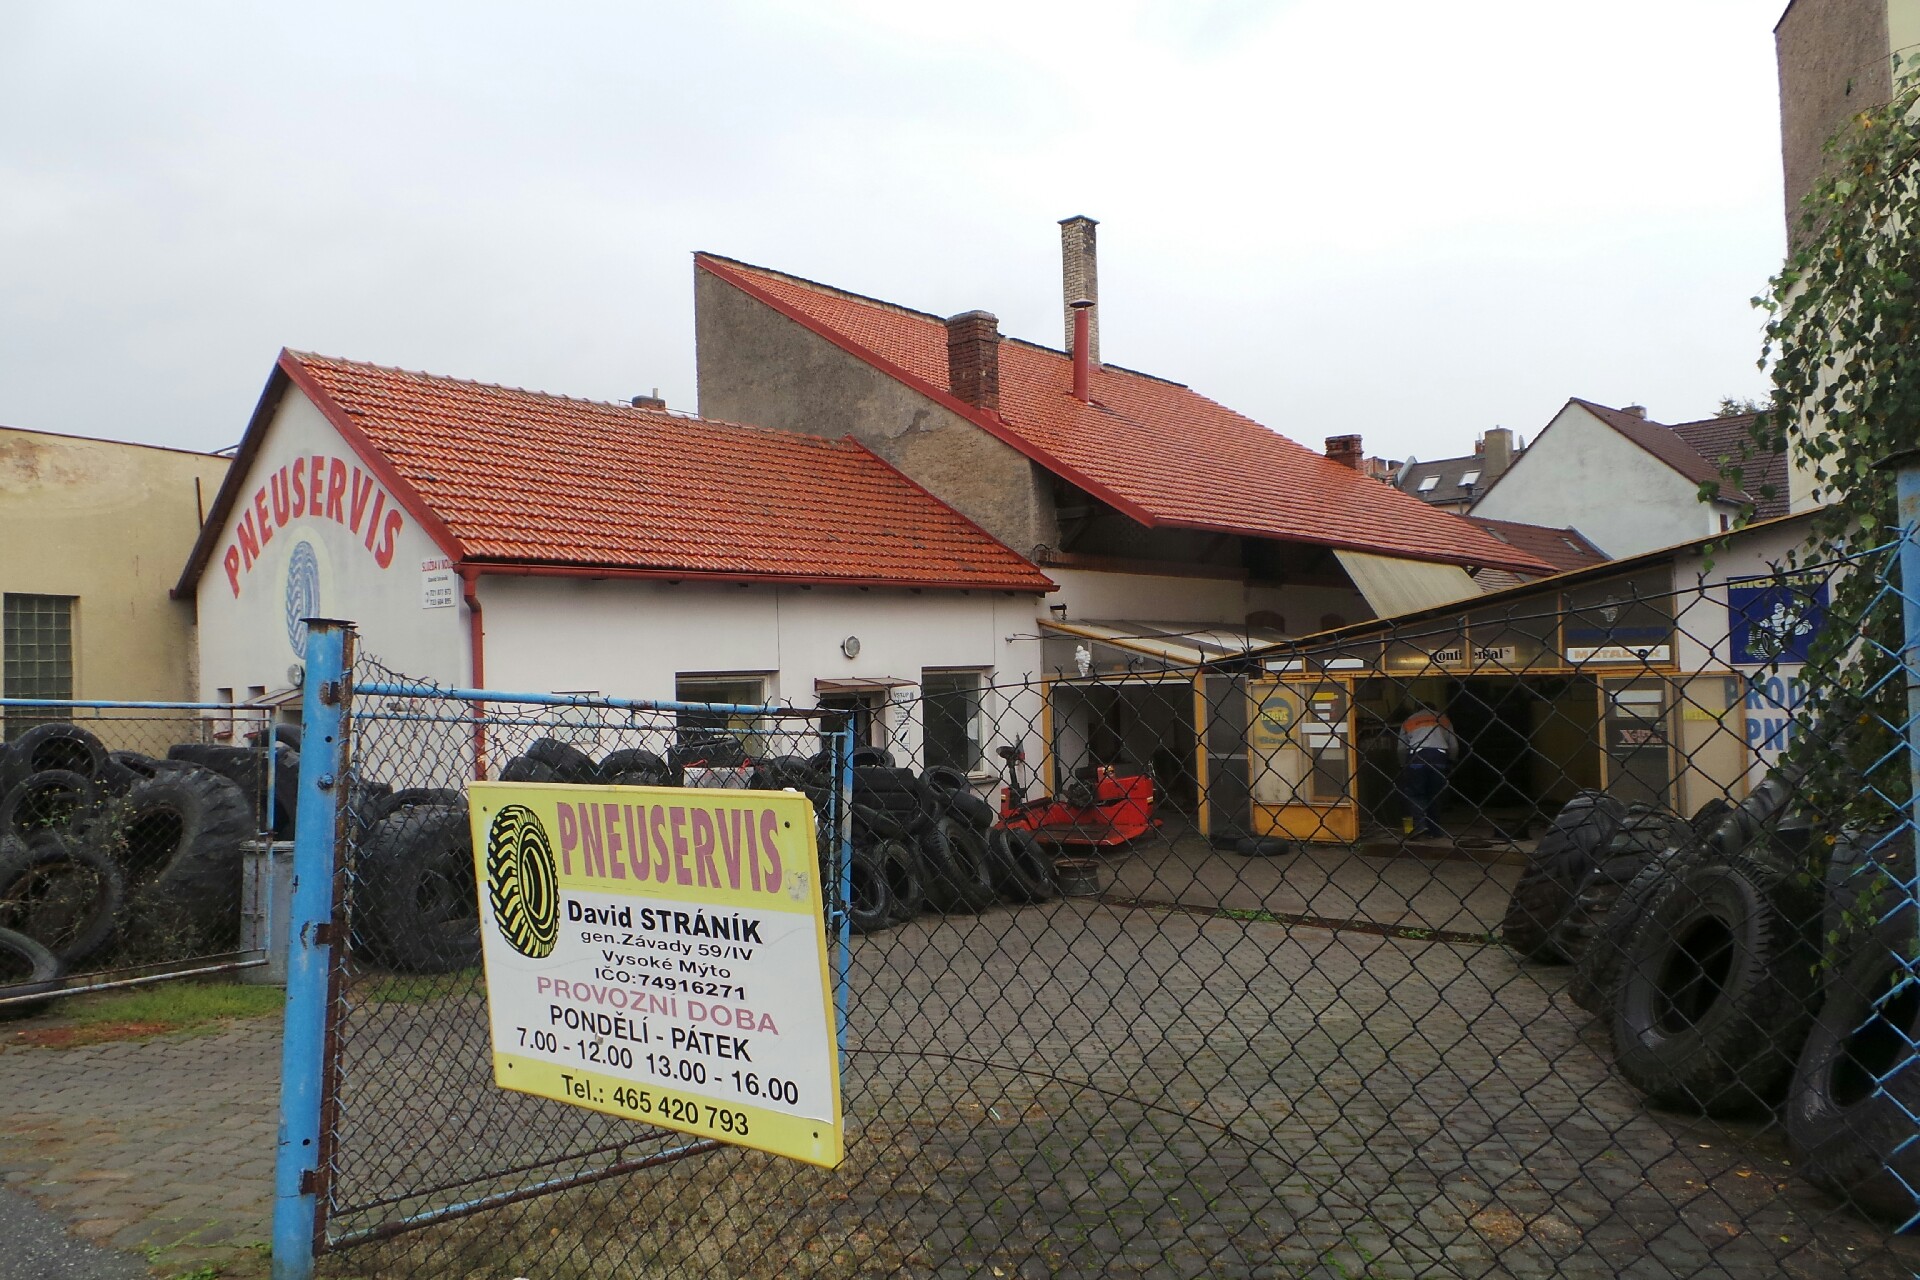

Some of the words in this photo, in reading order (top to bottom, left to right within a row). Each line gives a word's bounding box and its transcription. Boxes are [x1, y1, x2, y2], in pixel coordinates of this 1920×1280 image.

[223, 455, 404, 600] PNEUSERVIS
[556, 801, 783, 894] PNEUSERVIS
[567, 900, 632, 929] David
[640, 907, 763, 945] STRÁNÍK
[581, 931, 692, 956] gen.Závady
[697, 943, 753, 961] 59/IV
[594, 966, 745, 1000] IČO:74916271
[602, 950, 673, 970] Vysoké
[679, 959, 731, 979] Mýto
[537, 976, 678, 1018] PROVOZNÍ
[687, 1000, 779, 1035] DOBA
[550, 1004, 649, 1044] PONDĚLÍ
[671, 1025, 752, 1062] PÁTEK
[516, 1027, 557, 1054] 7.00
[577, 1040, 633, 1069] 12.00
[646, 1053, 706, 1085] 13.00
[731, 1070, 799, 1106] 16.00
[561, 1074, 604, 1104] Tel.:
[613, 1086, 652, 1114] 465
[658, 1096, 699, 1125] 420
[705, 1105, 749, 1136] 793
